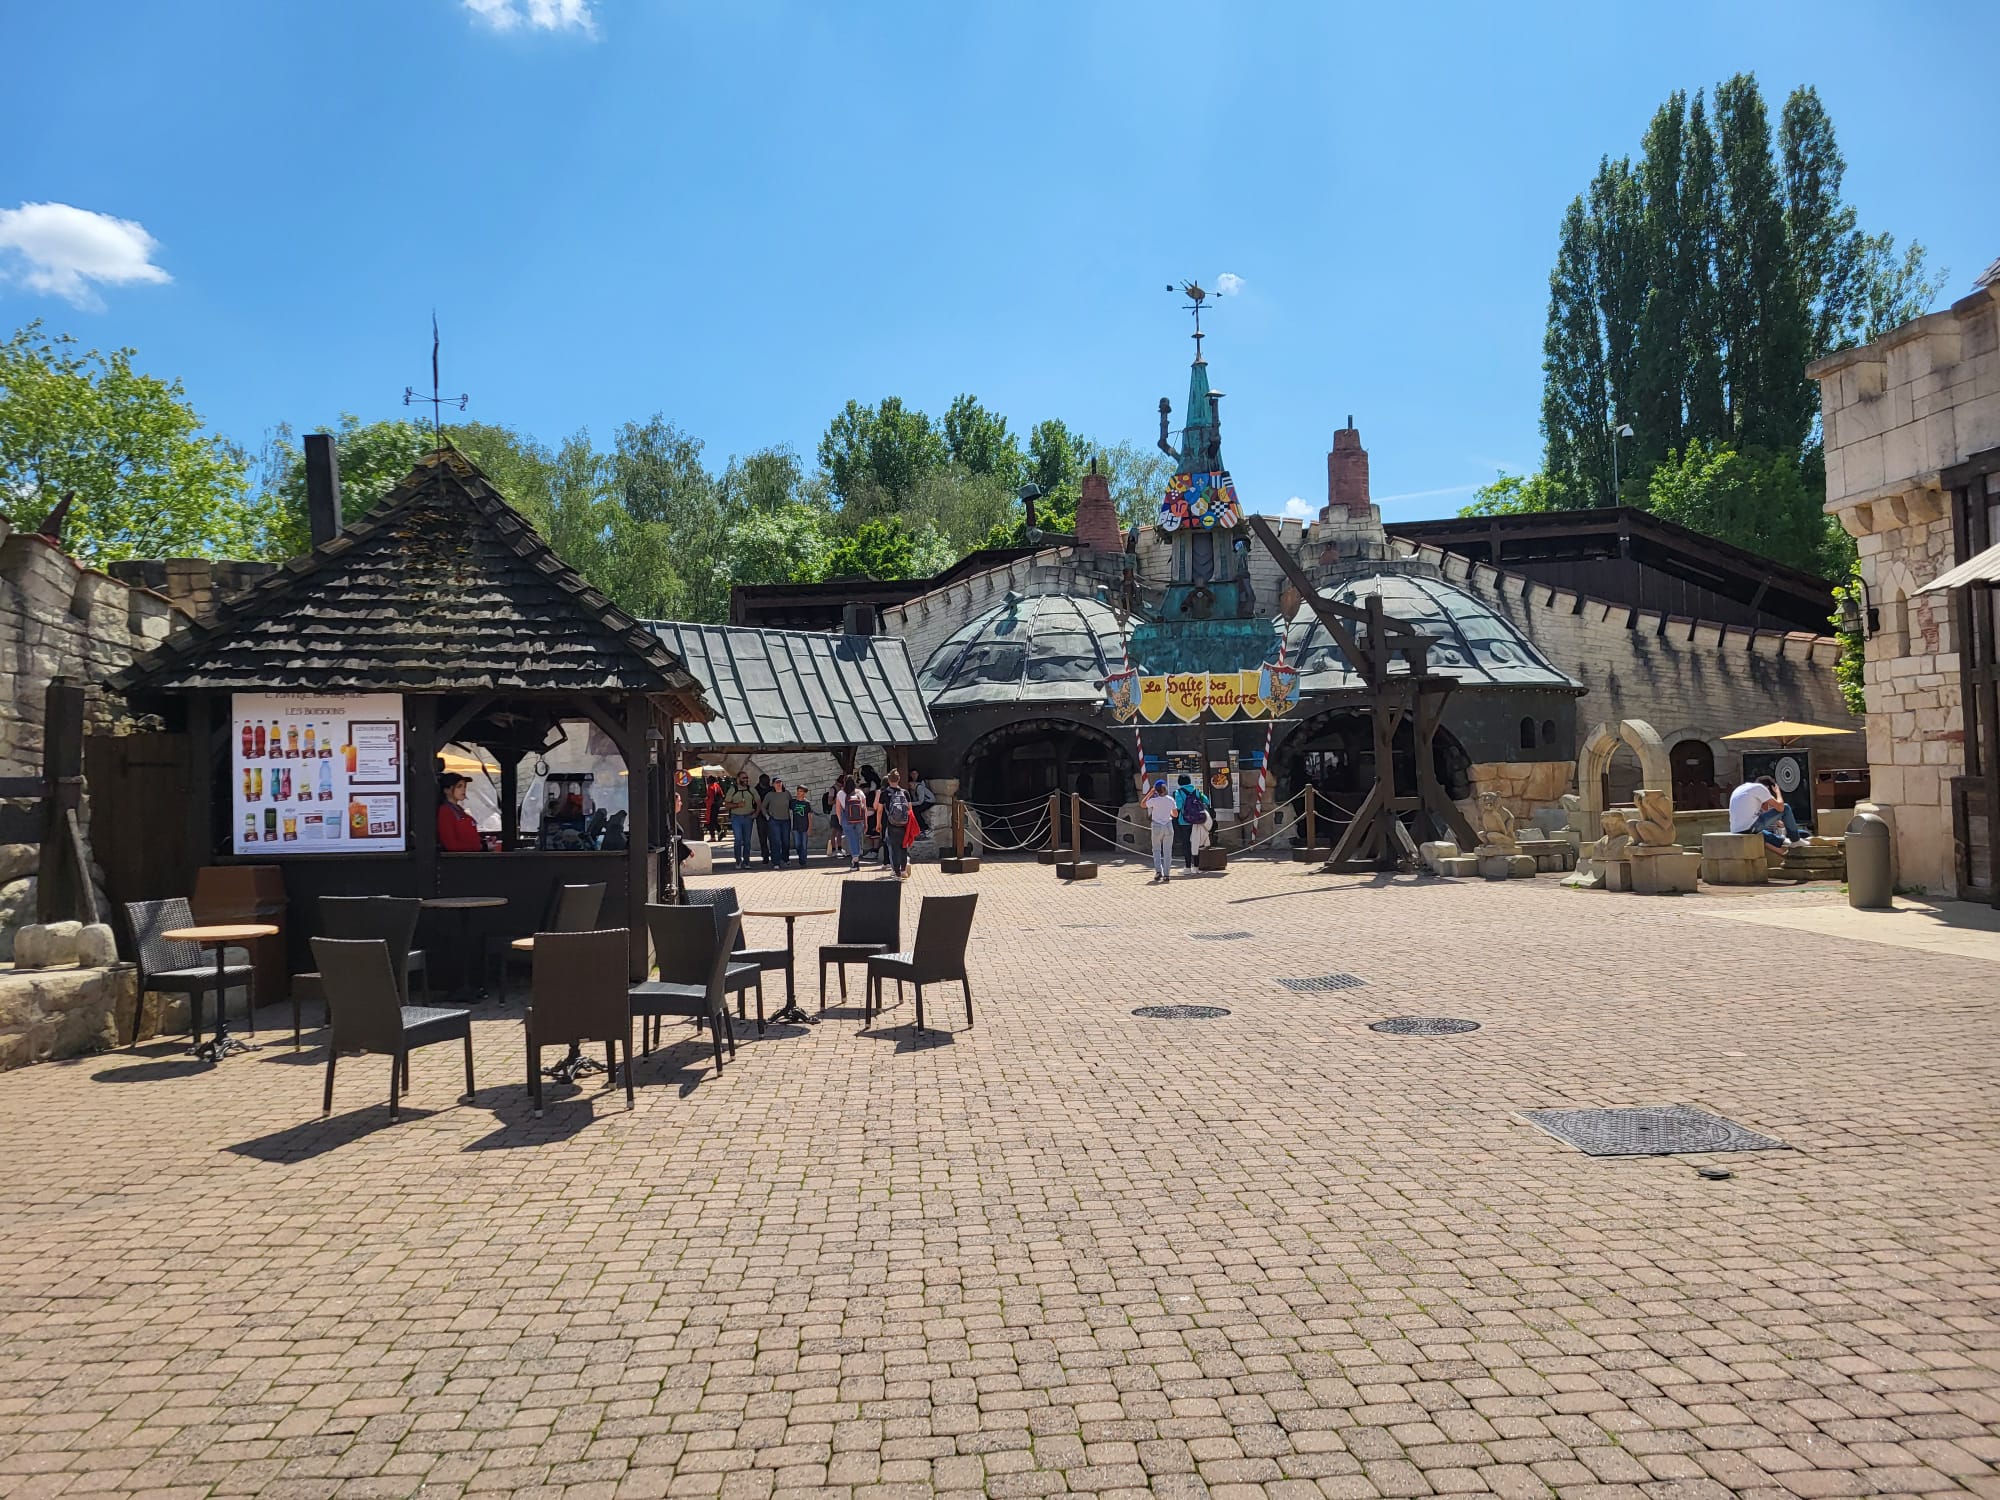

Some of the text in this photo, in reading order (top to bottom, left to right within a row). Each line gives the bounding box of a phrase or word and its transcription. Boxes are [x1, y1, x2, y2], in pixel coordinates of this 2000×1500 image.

[1144, 675, 1227, 694] La Halte des
[1181, 689, 1258, 711] Chevaliers
